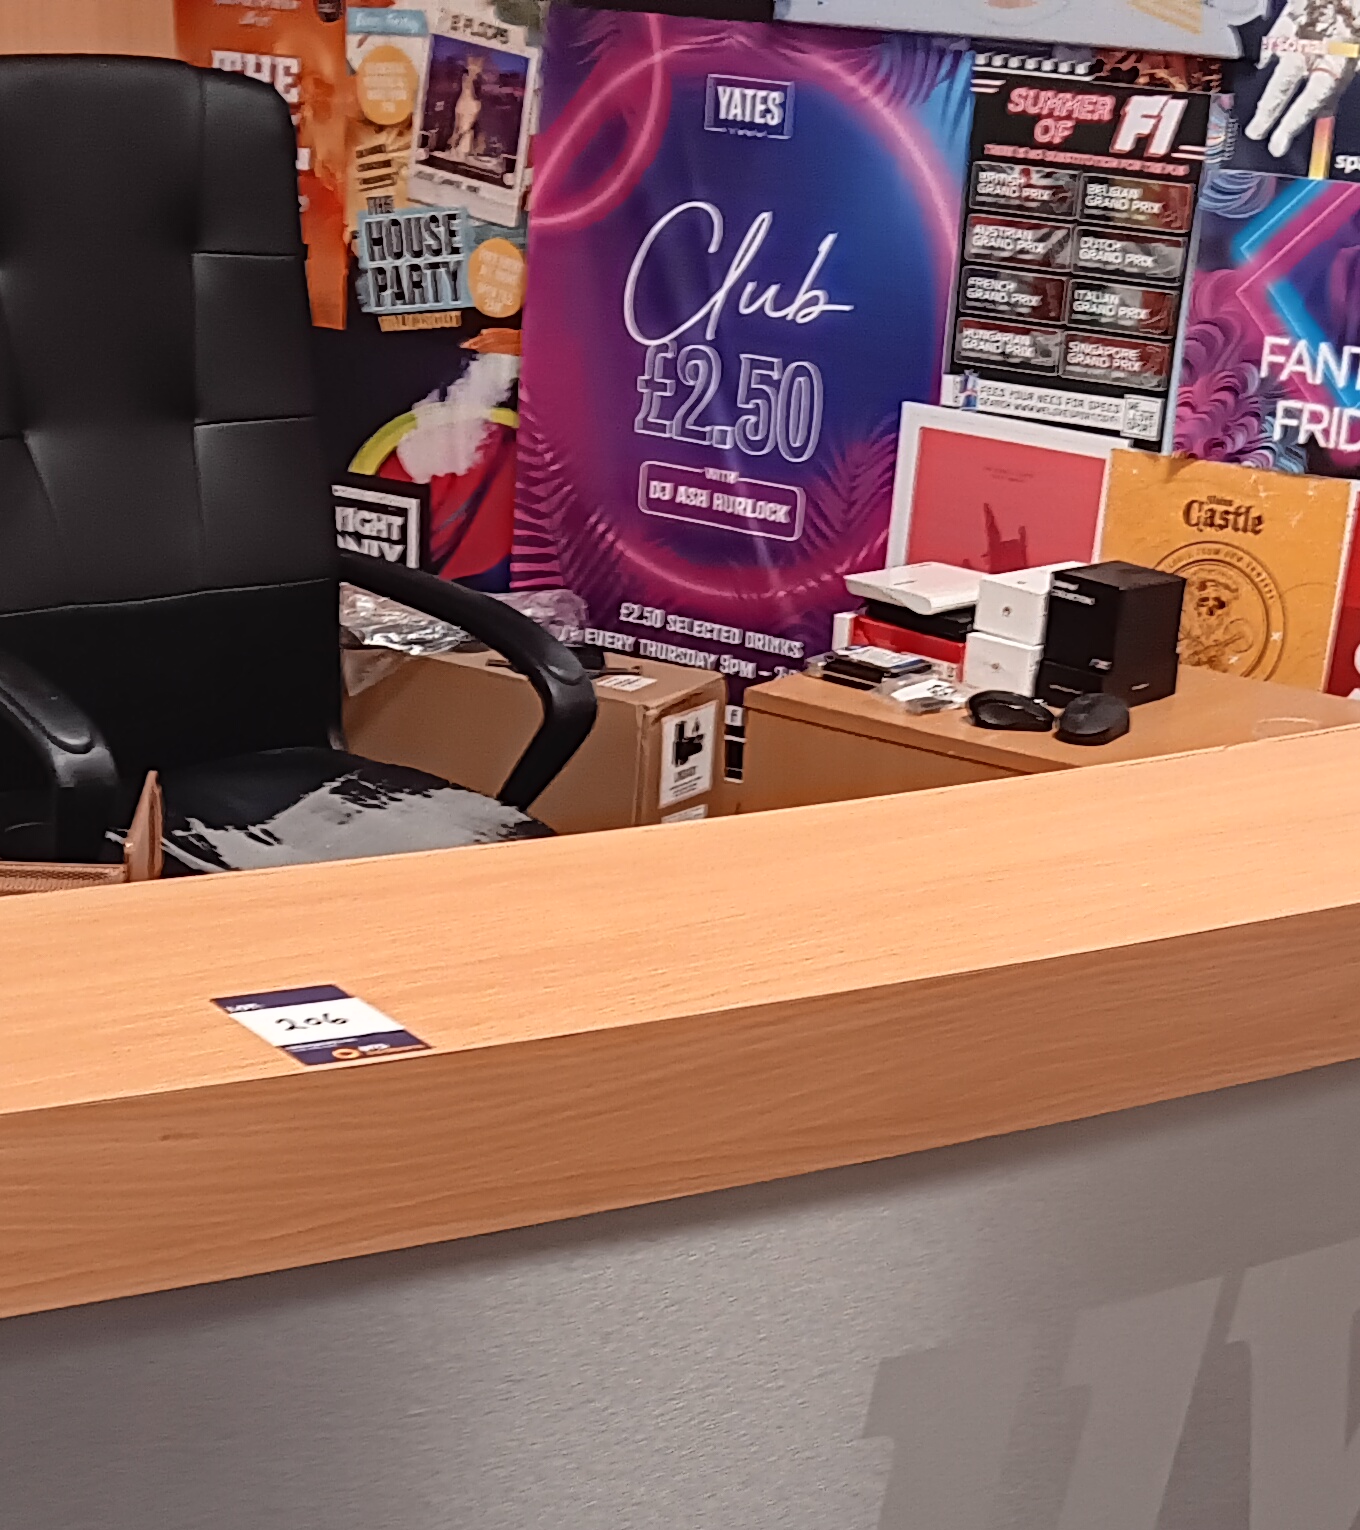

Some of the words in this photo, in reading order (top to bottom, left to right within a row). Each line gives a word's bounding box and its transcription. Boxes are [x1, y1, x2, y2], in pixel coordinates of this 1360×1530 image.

[717, 86, 785, 126] YATES
[1007, 87, 1116, 122] SUMMER
[1034, 118, 1076, 144] OF
[1110, 95, 1188, 157] F1
[977, 183, 1019, 198] GRAND
[1021, 188, 1053, 200] PRIX
[1087, 184, 1143, 199] BELGIAN
[1085, 197, 1128, 211] GRAND
[1131, 201, 1164, 214] PRIX
[366, 214, 462, 261] HOUSE
[973, 225, 1032, 240] AUSTRIAN
[972, 237, 1013, 249] GRAND
[1015, 241, 1045, 254] PRIX
[1080, 237, 1122, 251] DUTCH
[1079, 250, 1122, 264] GRAND
[1125, 254, 1156, 268] PRIX
[624, 201, 854, 345] Club
[370, 261, 463, 308] PARTY
[967, 277, 1017, 291] FRENCH
[966, 288, 1007, 303] GRAND
[1011, 294, 1043, 307] PRIX
[1074, 290, 1120, 304] ITALIAN
[1073, 301, 1116, 315] GRAND
[1118, 306, 1152, 320] PRIX
[963, 328, 1031, 345] HUNGARIAN
[962, 338, 1003, 353] GRAND
[1005, 345, 1035, 358] PRIX
[1068, 341, 1140, 360] SINGAPORE
[1067, 353, 1109, 368] GRAND
[1112, 359, 1143, 372] PRIX
[634, 340, 823, 462] £2.50
[704, 467, 739, 483] WITH
[649, 481, 674, 499] DJ
[675, 486, 711, 508] ASH
[712, 492, 791, 523] HURLOCK
[1182, 499, 1265, 536] Castle
[620, 603, 665, 628] £2.50
[666, 615, 743, 644] SELECTED
[744, 631, 804, 658] DRINKS
[584, 628, 636, 651] EVERY
[638, 639, 719, 670] THURSDAY
[720, 655, 756, 679] 9PM
